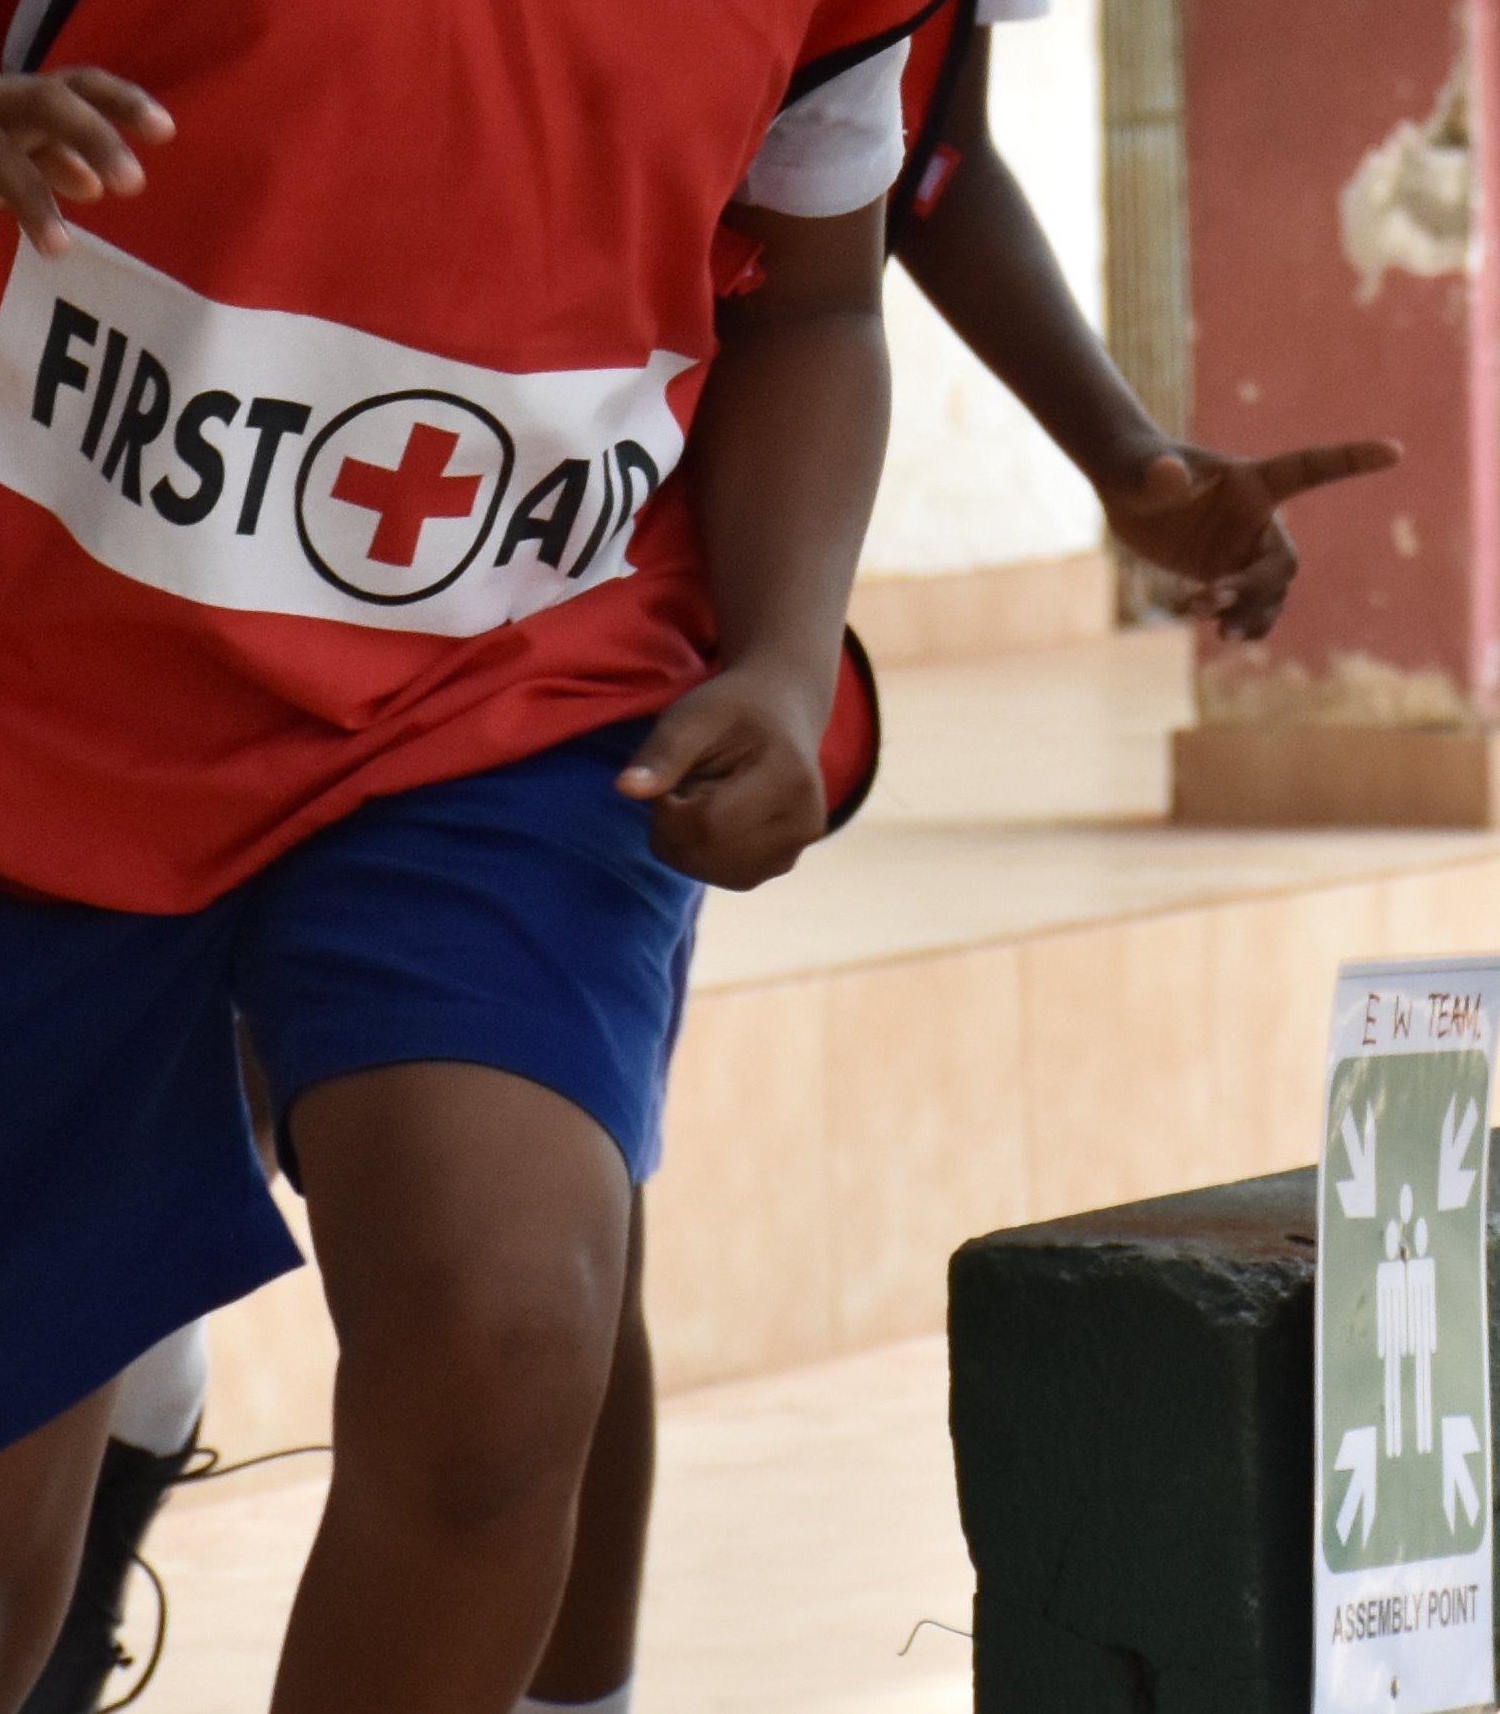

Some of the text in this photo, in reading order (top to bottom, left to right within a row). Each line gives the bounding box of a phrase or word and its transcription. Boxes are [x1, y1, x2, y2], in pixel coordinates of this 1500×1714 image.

[31, 297, 660, 579] FIRST AID
[1332, 1584, 1480, 1646] ASSEMBLY POINT
